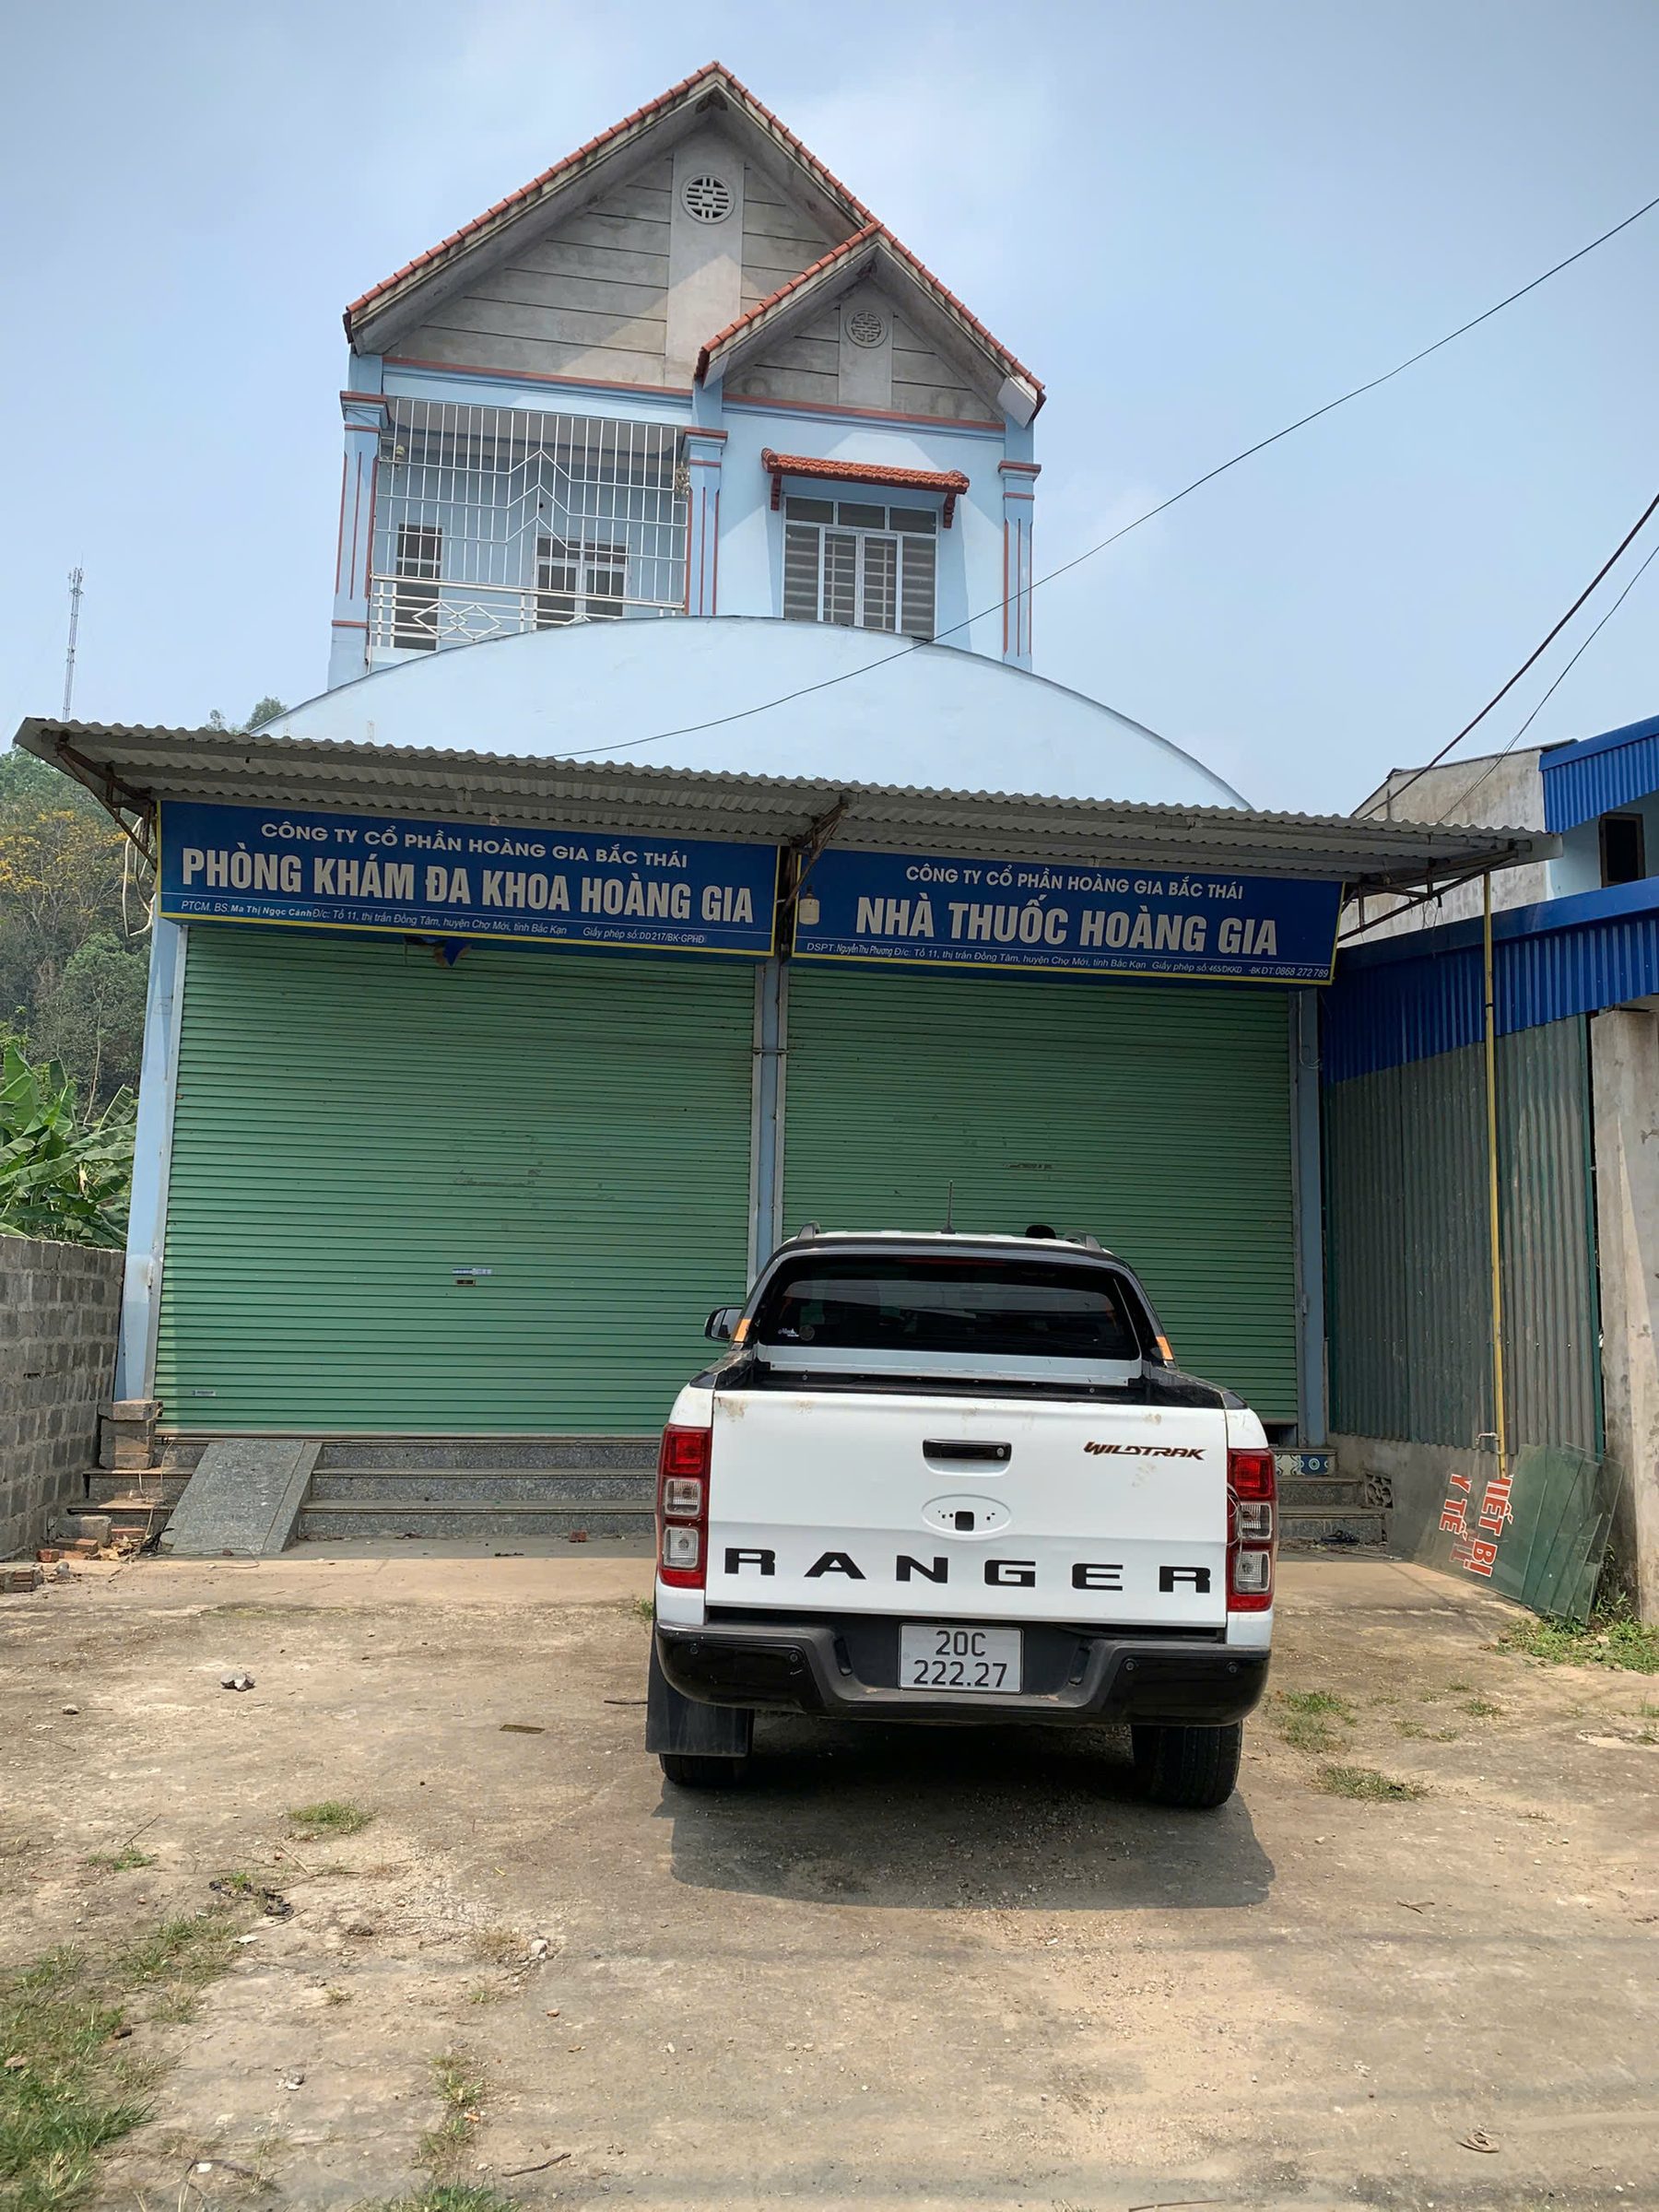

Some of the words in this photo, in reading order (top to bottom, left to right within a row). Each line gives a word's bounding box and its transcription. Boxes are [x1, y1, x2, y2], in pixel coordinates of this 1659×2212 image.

[261, 820, 328, 841] CÔNG
[335, 828, 358, 843] TY
[364, 825, 397, 846] CỔ
[405, 830, 462, 852] PHẦN
[468, 838, 546, 858] HOÀNG
[552, 846, 590, 861] GIA
[595, 843, 638, 865] BẮC
[643, 850, 688, 868] THÁI
[182, 842, 302, 894] PHÒNG
[313, 853, 415, 900] KHÁM
[425, 865, 472, 904] ĐA
[482, 869, 571, 912] KHOA
[581, 872, 691, 920] HOÀNG
[700, 885, 754, 924] GIA
[906, 863, 959, 882] CÔNG
[963, 869, 982, 885] TY
[985, 864, 1013, 887] CỔ
[1018, 867, 1063, 889] PHẦN
[1067, 874, 1129, 893] HOÀNG
[1134, 880, 1163, 896] GIA
[1169, 876, 1203, 898] BẮC
[1207, 881, 1243, 900] THÁI
[855, 892, 935, 938] NHÀ
[948, 894, 1069, 946] THUỐC
[1079, 905, 1207, 952] HOÀNG
[1218, 917, 1277, 956] GIA
[1083, 1441, 1206, 1461] WILDTRAK
[1439, 1499, 1469, 1542] TẾ
[724, 1547, 1211, 1594] RANGER
[1463, 1537, 1499, 1578] BỊ
[935, 1630, 986, 1657] 20C
[913, 1659, 1007, 1688] 222.27
